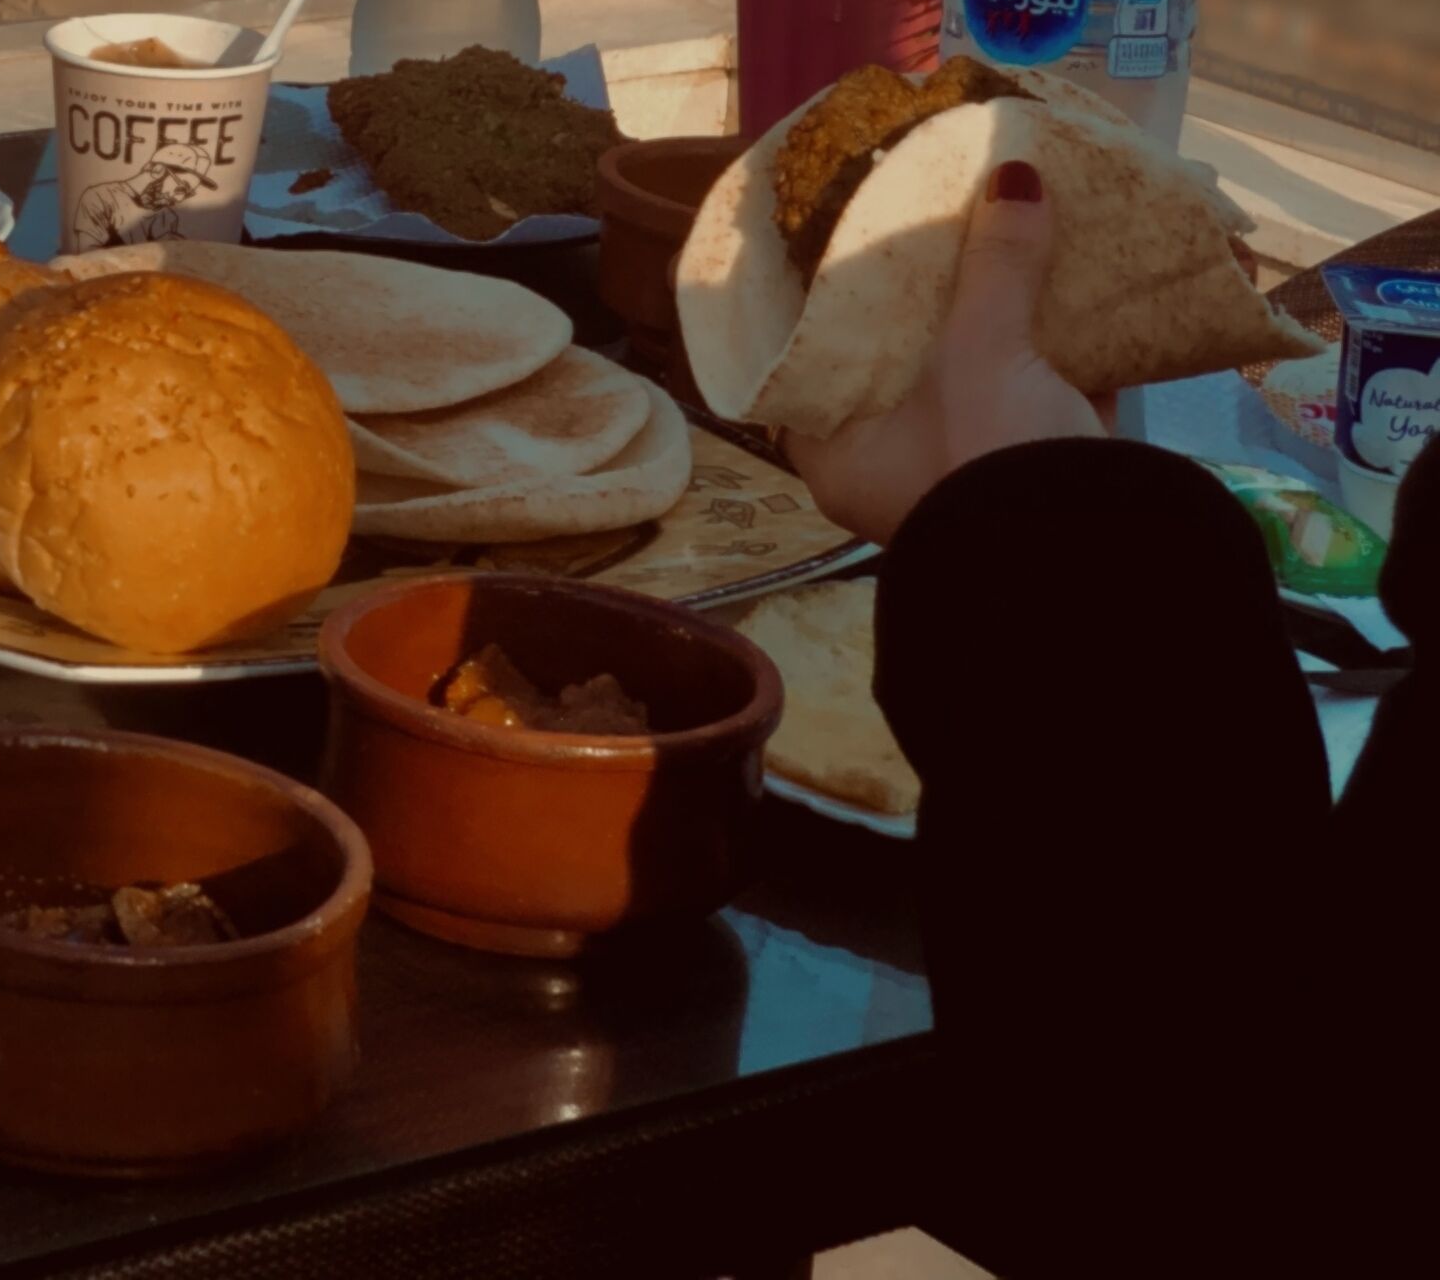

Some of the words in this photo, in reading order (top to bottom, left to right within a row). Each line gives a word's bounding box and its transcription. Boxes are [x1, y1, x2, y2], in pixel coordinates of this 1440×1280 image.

[68, 87, 107, 104] ENJOY
[116, 98, 157, 111] YOUR
[166, 102, 203, 112] TIME
[211, 99, 243, 110] WITH
[67, 103, 243, 166] COFFEE
